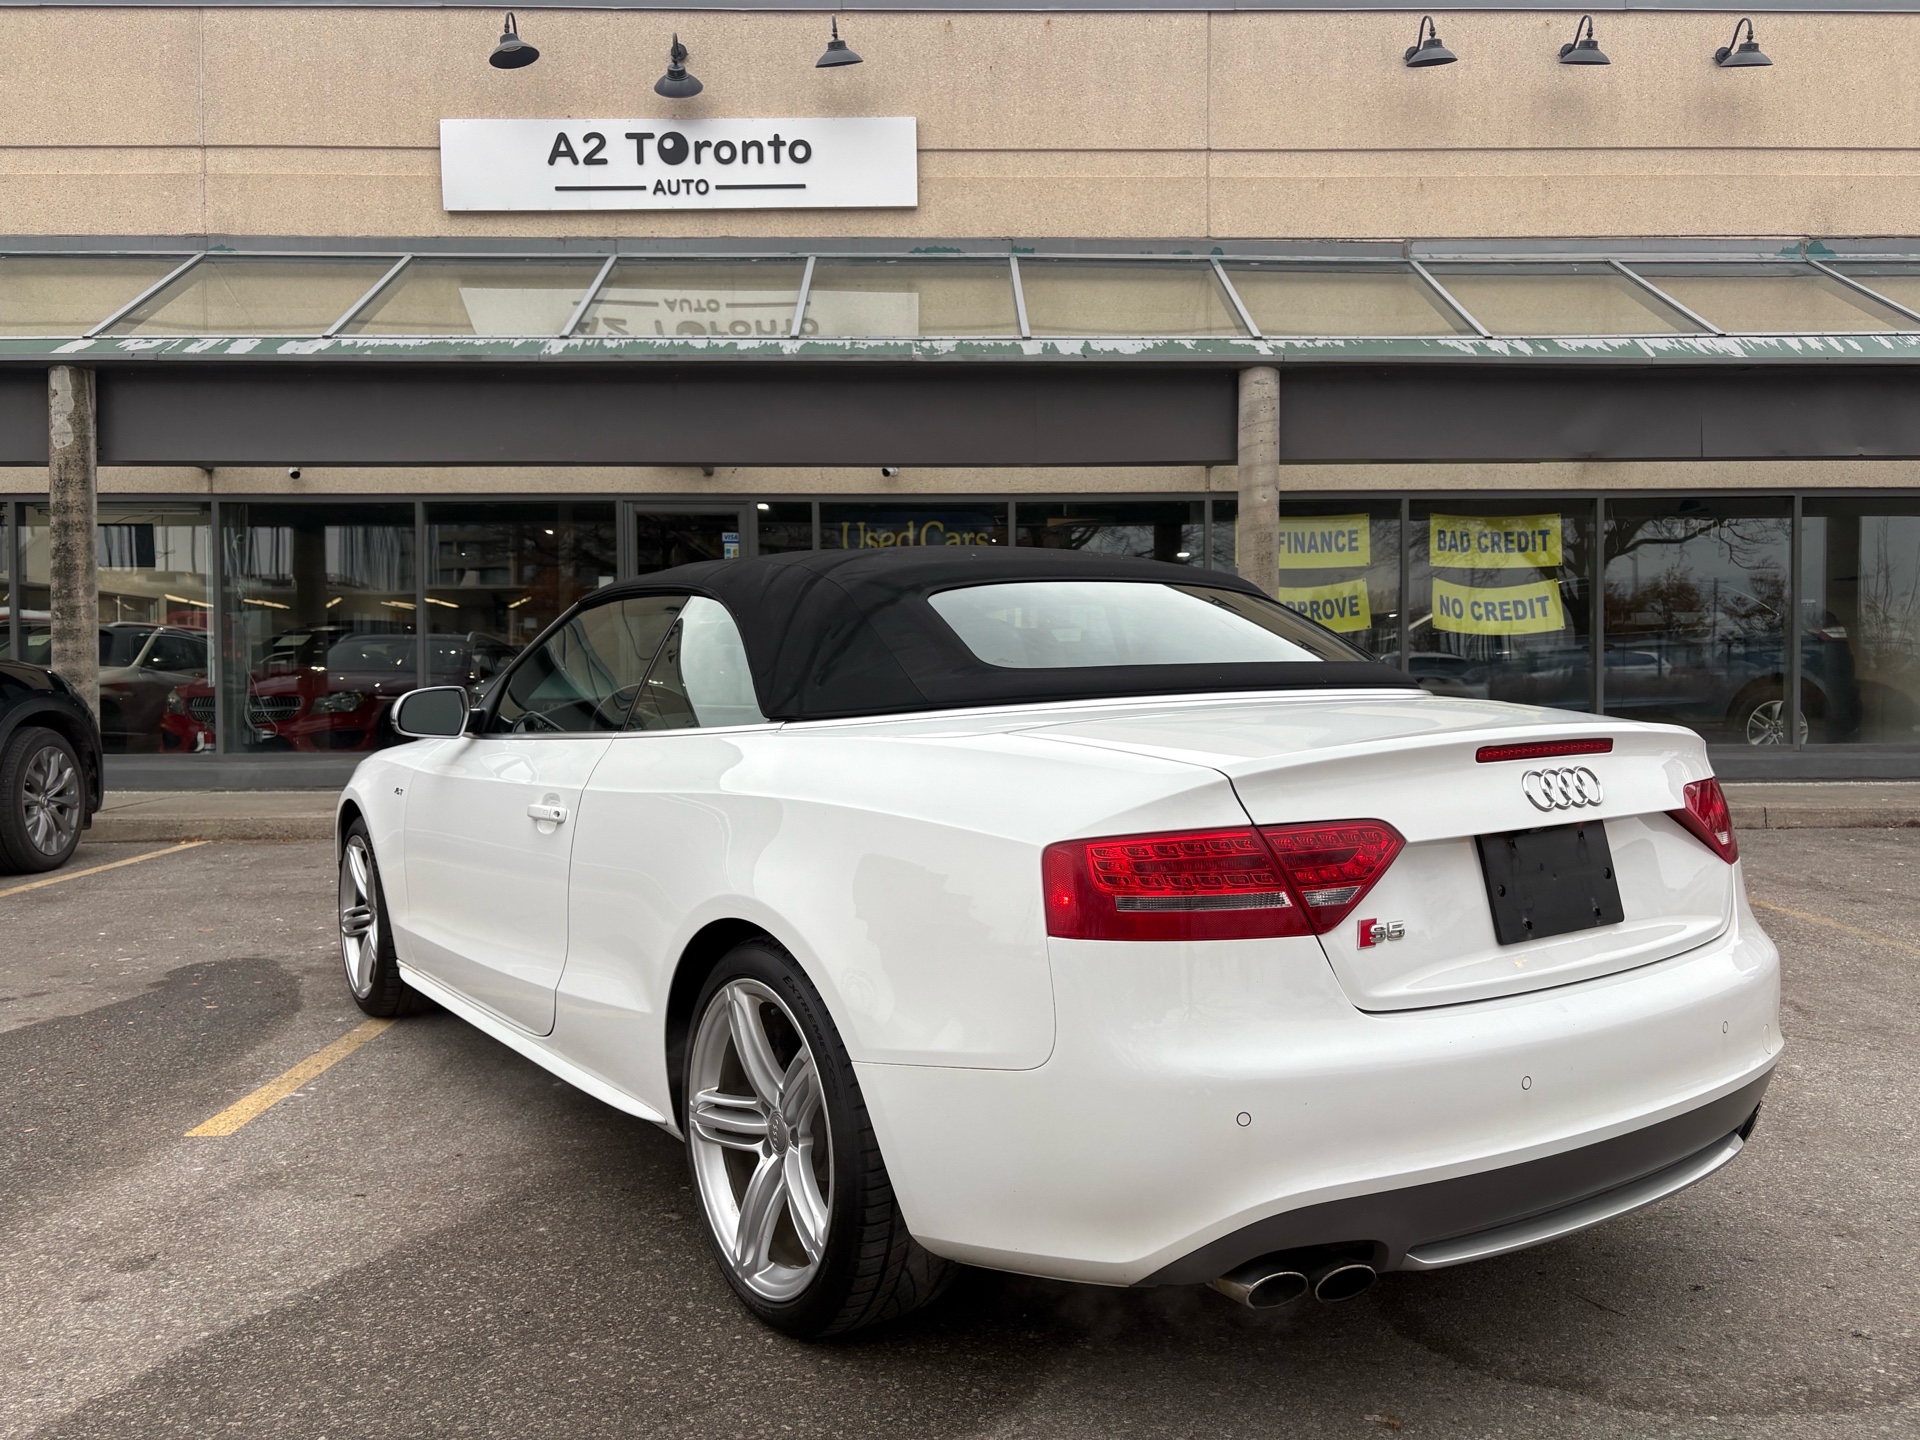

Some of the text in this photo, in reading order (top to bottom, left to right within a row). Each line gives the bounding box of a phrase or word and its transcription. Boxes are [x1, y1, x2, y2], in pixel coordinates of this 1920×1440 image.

[548, 132, 608, 166] A2
[652, 178, 710, 196] AUTO
[841, 520, 989, 549] Used Cars
[1279, 529, 1359, 554] FINANCE
[1437, 529, 1551, 554] BAD CREDIT
[1286, 594, 1361, 621] PPROVE
[1439, 594, 1550, 622] NO CREDIT
[1369, 920, 1406, 943] S5
